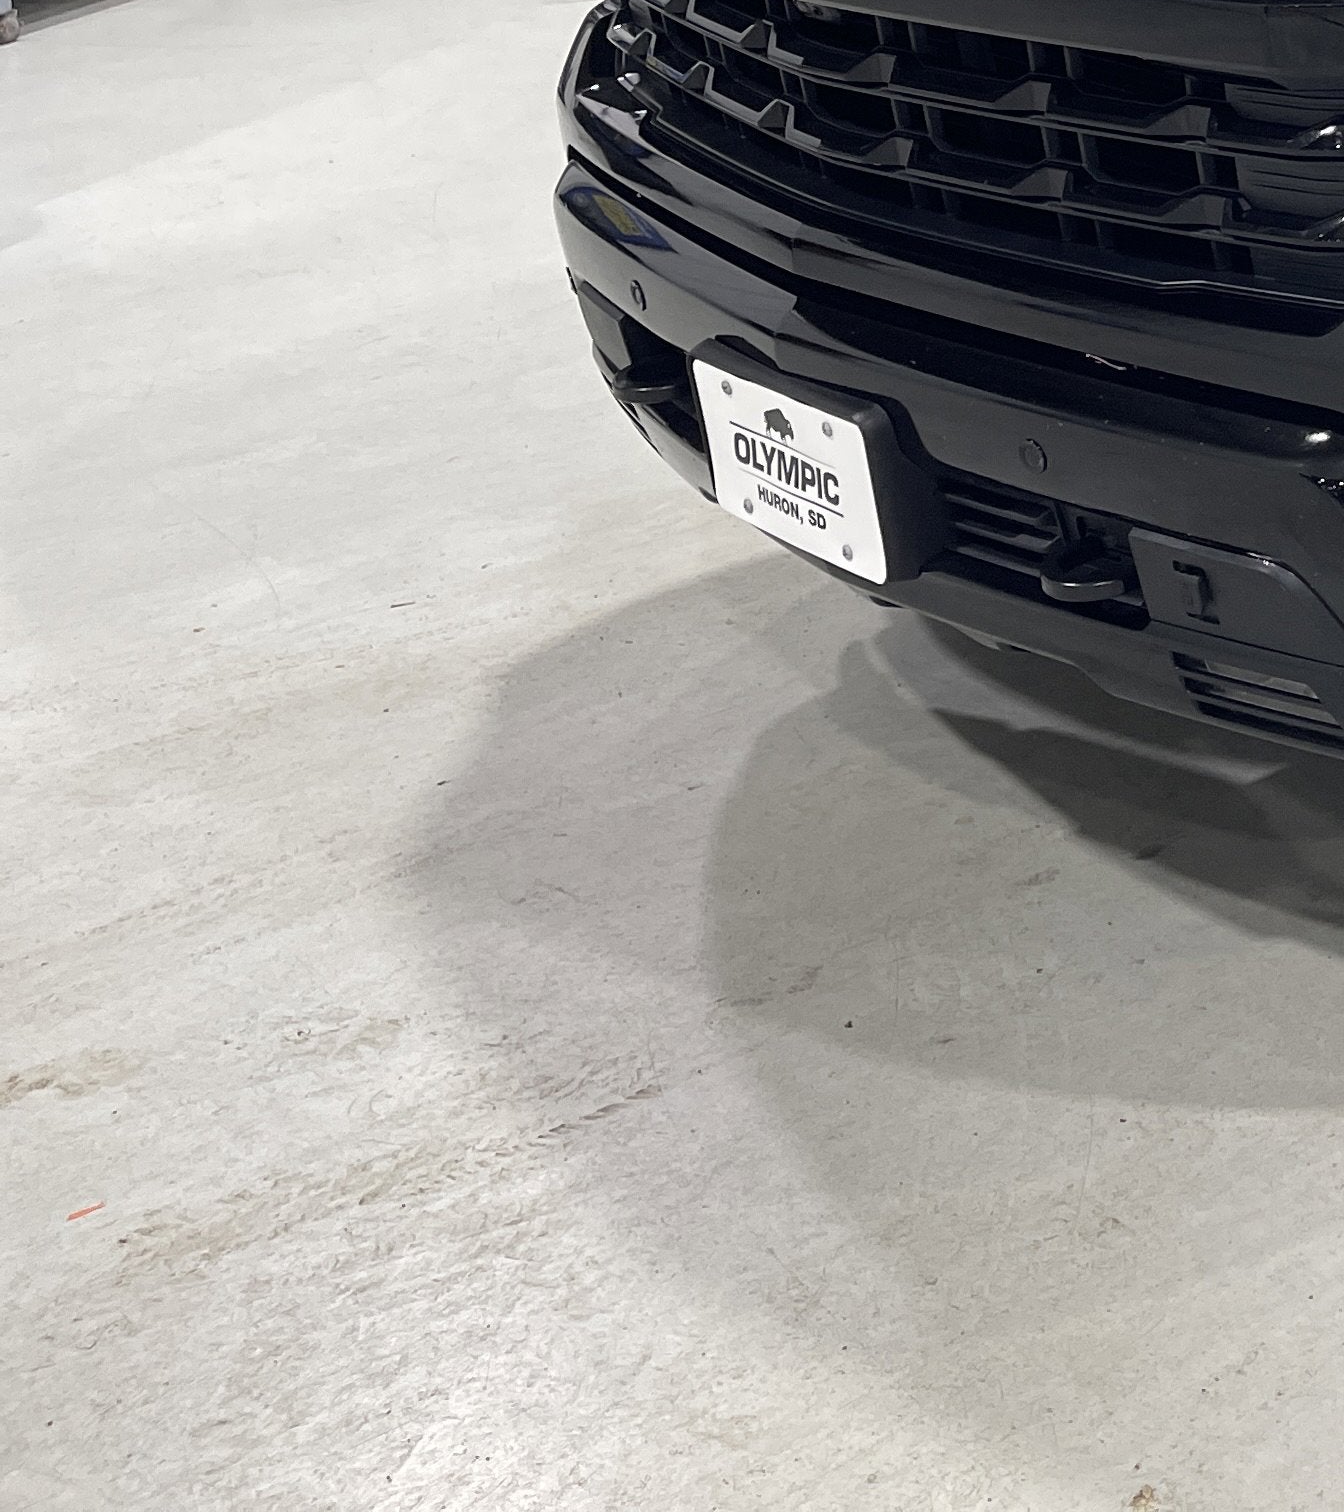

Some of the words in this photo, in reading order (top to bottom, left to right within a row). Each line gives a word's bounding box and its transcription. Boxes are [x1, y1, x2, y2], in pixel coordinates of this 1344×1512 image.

[734, 432, 840, 506] OLYMPIC
[757, 484, 804, 525] HURON,
[808, 509, 827, 530] SD
